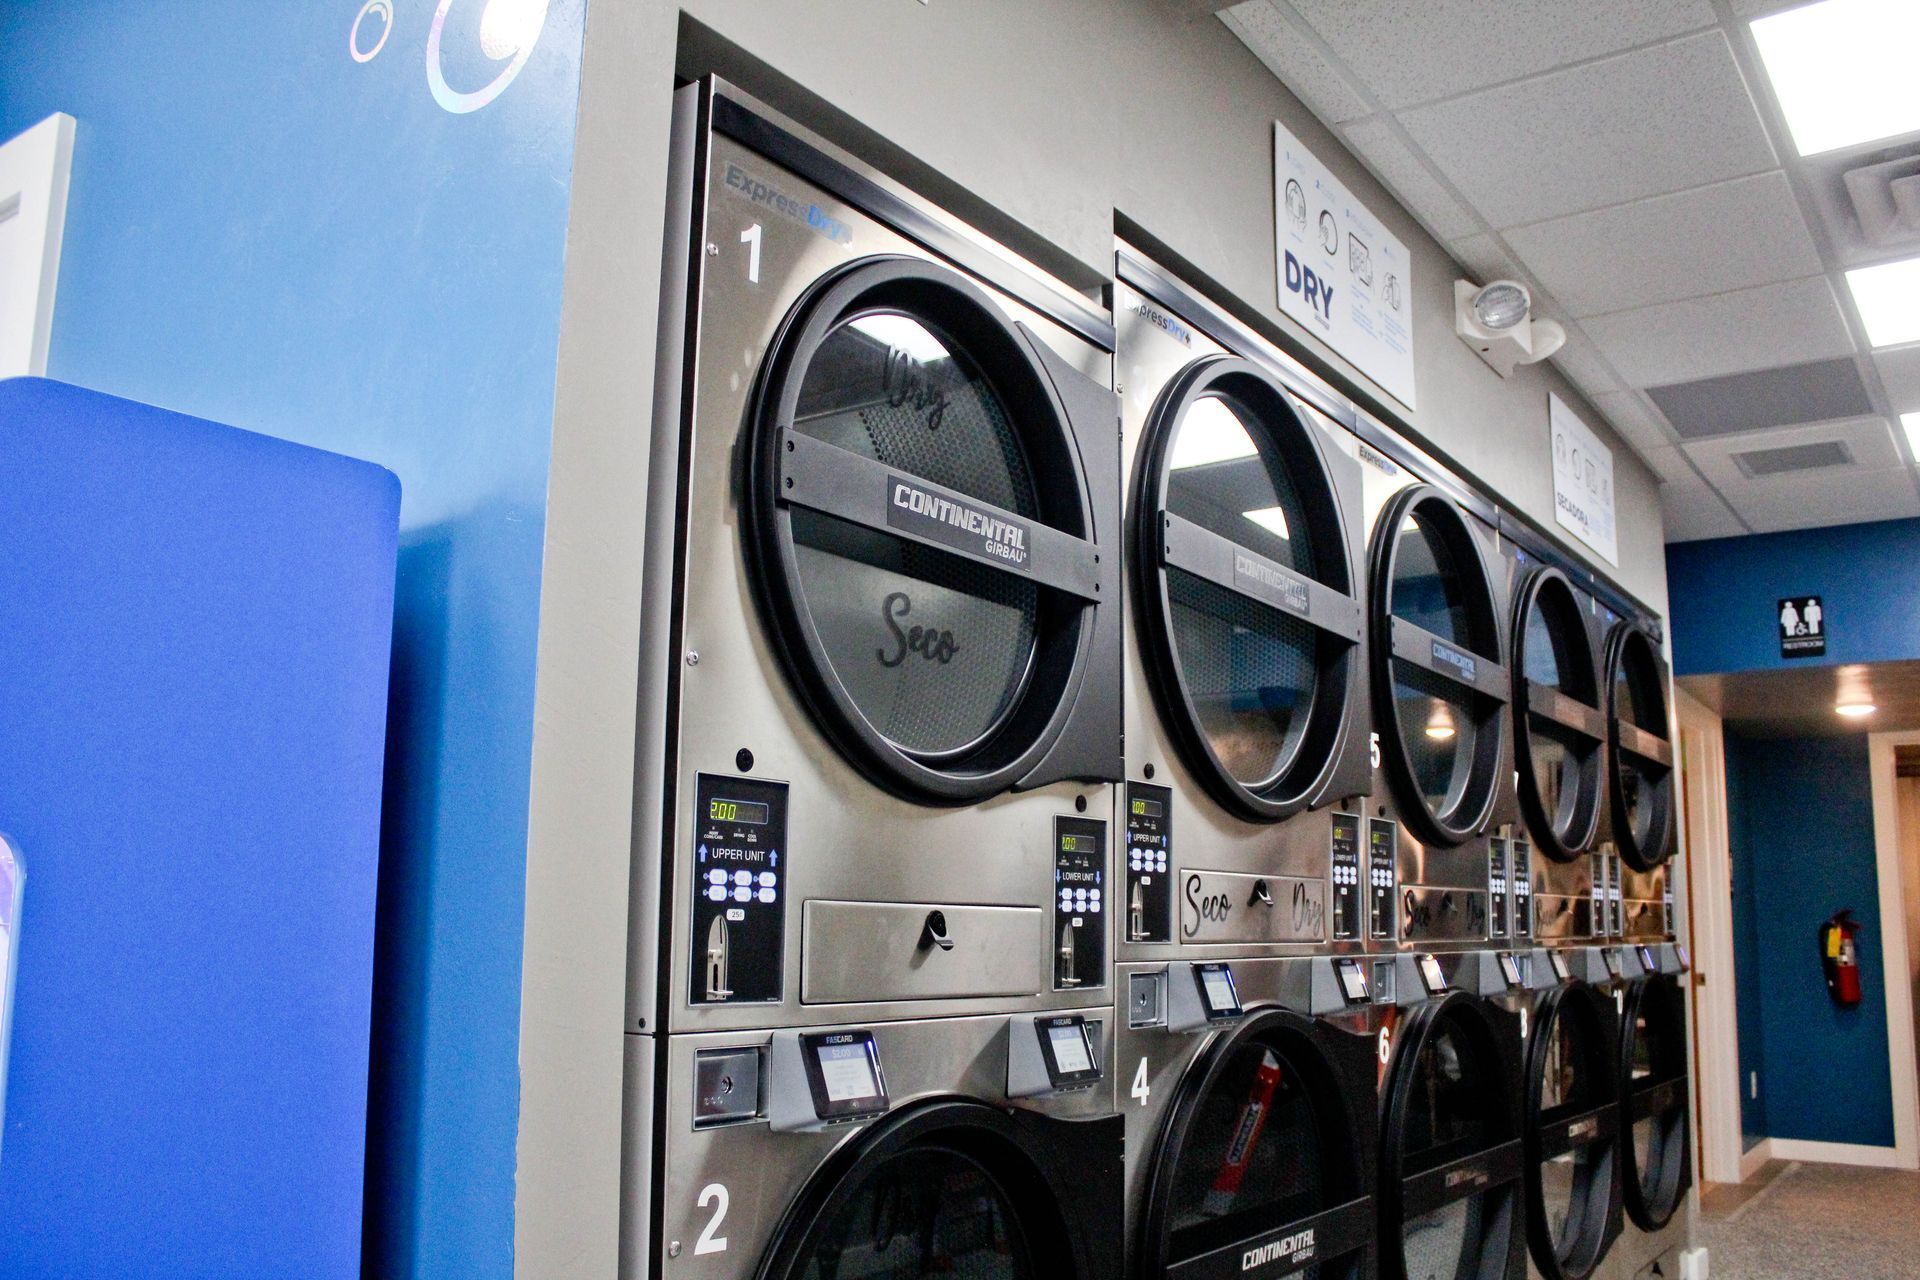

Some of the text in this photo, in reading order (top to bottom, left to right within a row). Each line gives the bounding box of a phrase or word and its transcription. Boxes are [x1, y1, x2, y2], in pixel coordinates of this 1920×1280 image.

[741, 223, 762, 283] 1
[1285, 248, 1334, 320] DRY
[894, 484, 1025, 550] CONTINENTAL
[876, 591, 960, 667] Seco
[1369, 732, 1380, 769] 5
[712, 847, 765, 861] UPPER UNIT
[1062, 872, 1094, 881] LOWER UNIT
[1184, 874, 1232, 937] Seco
[1293, 882, 1322, 937] Dry
[826, 1035, 853, 1044] FASCARD
[1379, 1026, 1390, 1064] 6
[1131, 1057, 1150, 1106] 4
[694, 1183, 730, 1256] 2
[1242, 1229, 1315, 1271] CONTINENTAL
